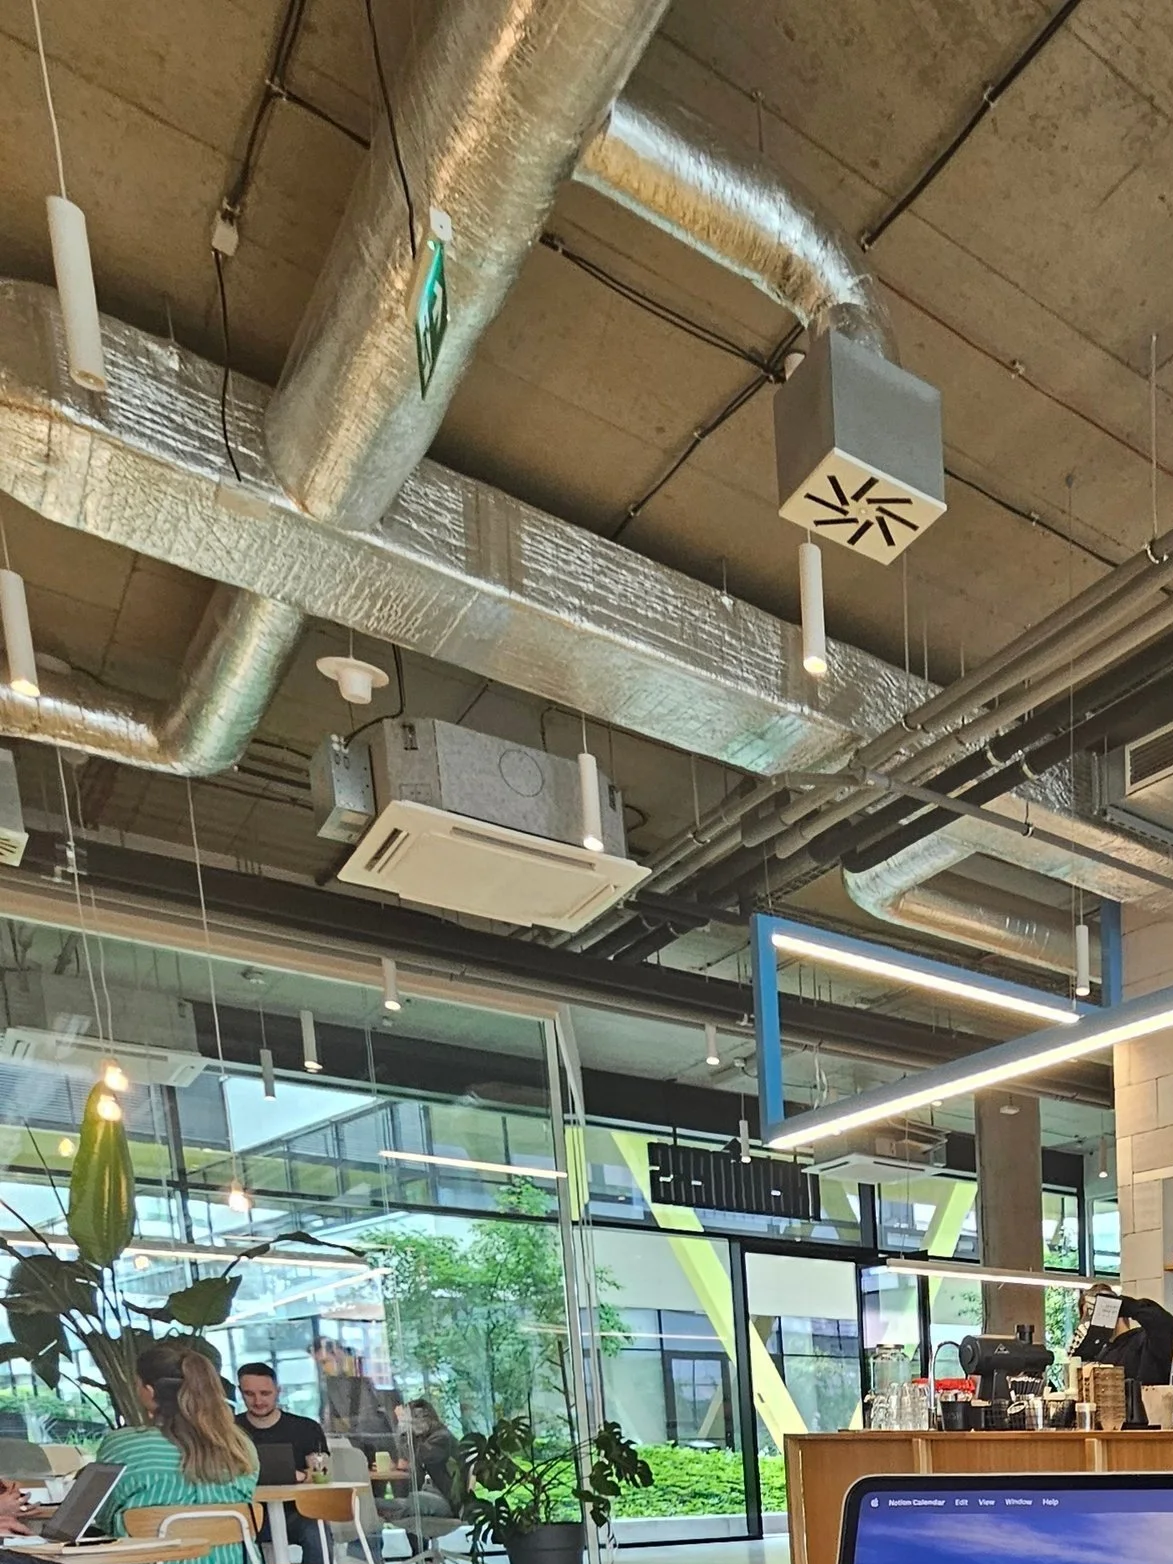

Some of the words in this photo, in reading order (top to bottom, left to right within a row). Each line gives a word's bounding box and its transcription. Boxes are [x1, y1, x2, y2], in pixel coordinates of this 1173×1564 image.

[954, 1498, 969, 1507] Edit
[978, 1498, 996, 1507] View
[1004, 1498, 1033, 1507] Window
[1042, 1498, 1060, 1507] Help
